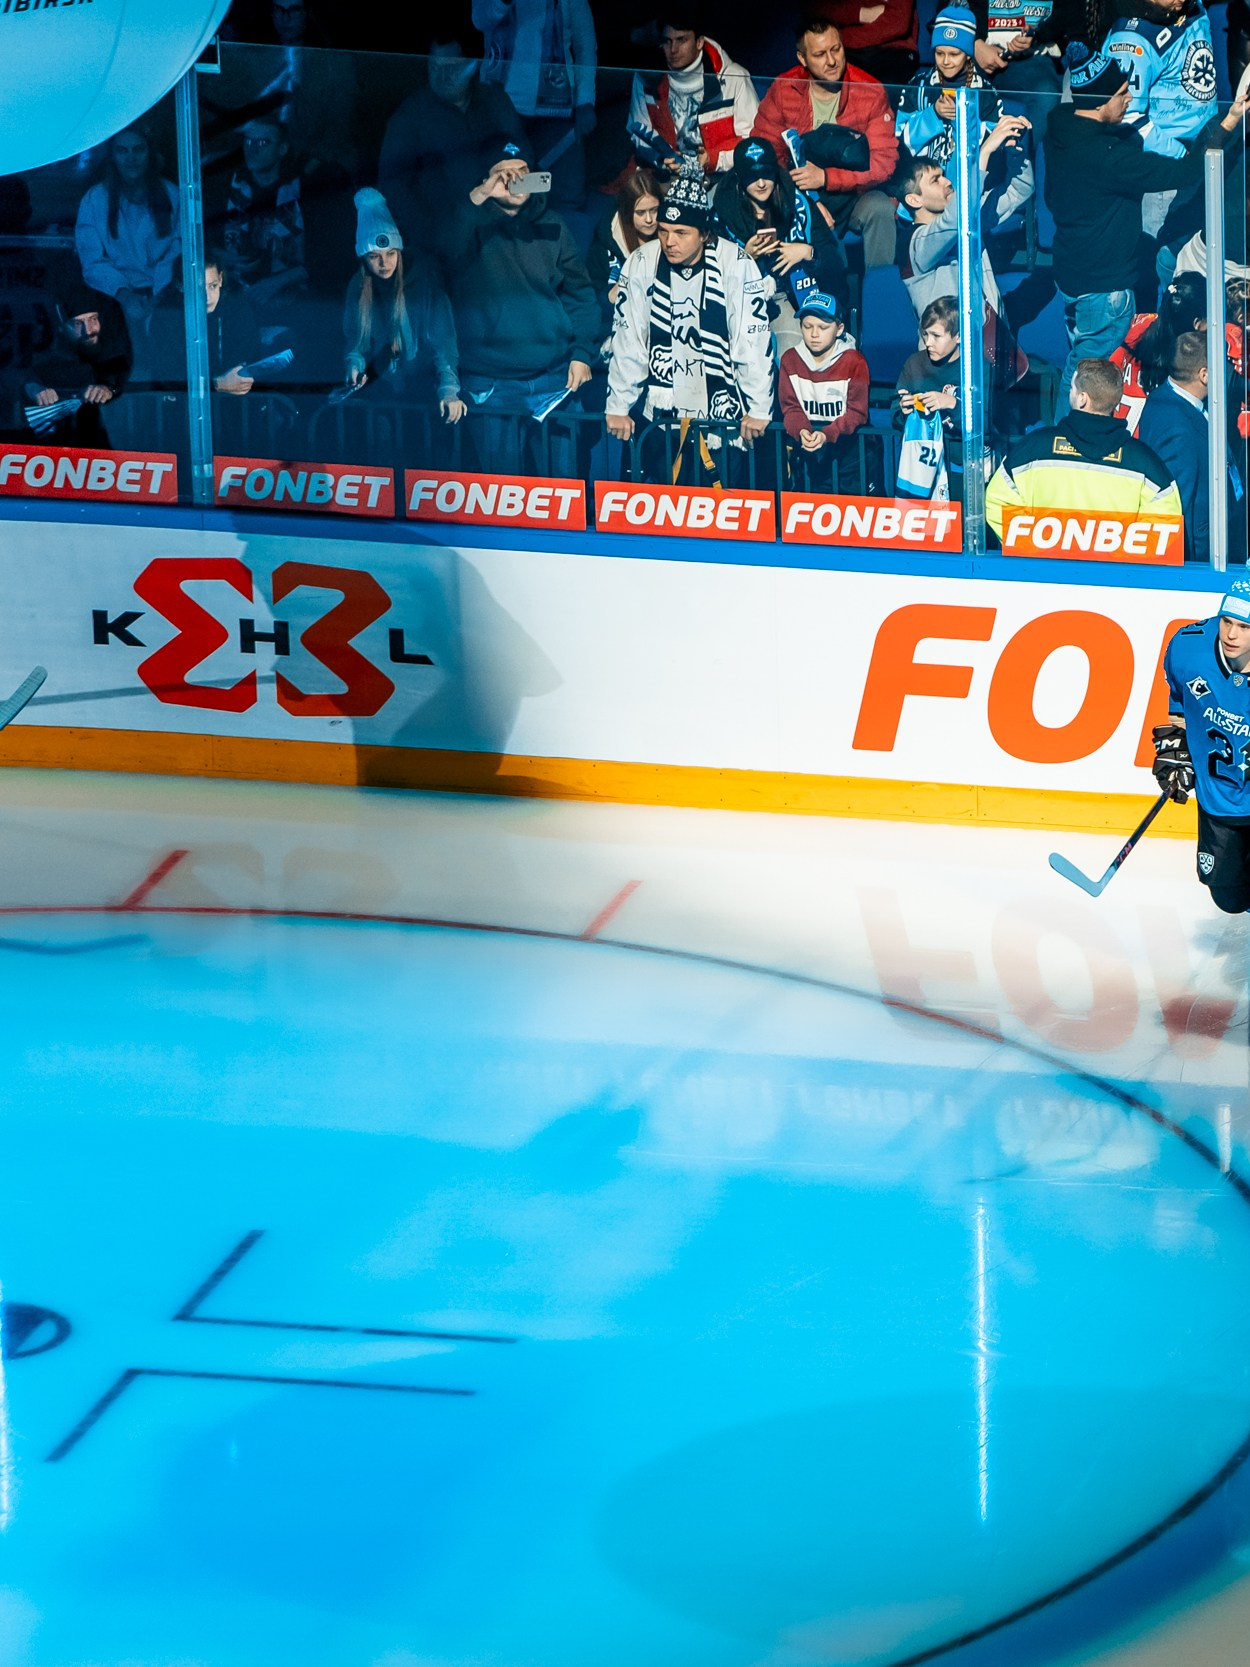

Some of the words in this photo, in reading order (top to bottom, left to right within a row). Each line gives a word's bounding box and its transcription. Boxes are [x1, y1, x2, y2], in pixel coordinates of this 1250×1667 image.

[995, 19, 1018, 27] 2023
[1111, 43, 1135, 52] Winline
[0, 453, 173, 494] FONBET
[218, 466, 391, 508] FONBET
[409, 479, 581, 520] FONBET
[599, 491, 772, 532] FONBET
[785, 502, 957, 542] FONBET
[1005, 515, 1180, 556] FONBET
[852, 603, 1200, 768] FO
[1216, 707, 1245, 722] FONBET
